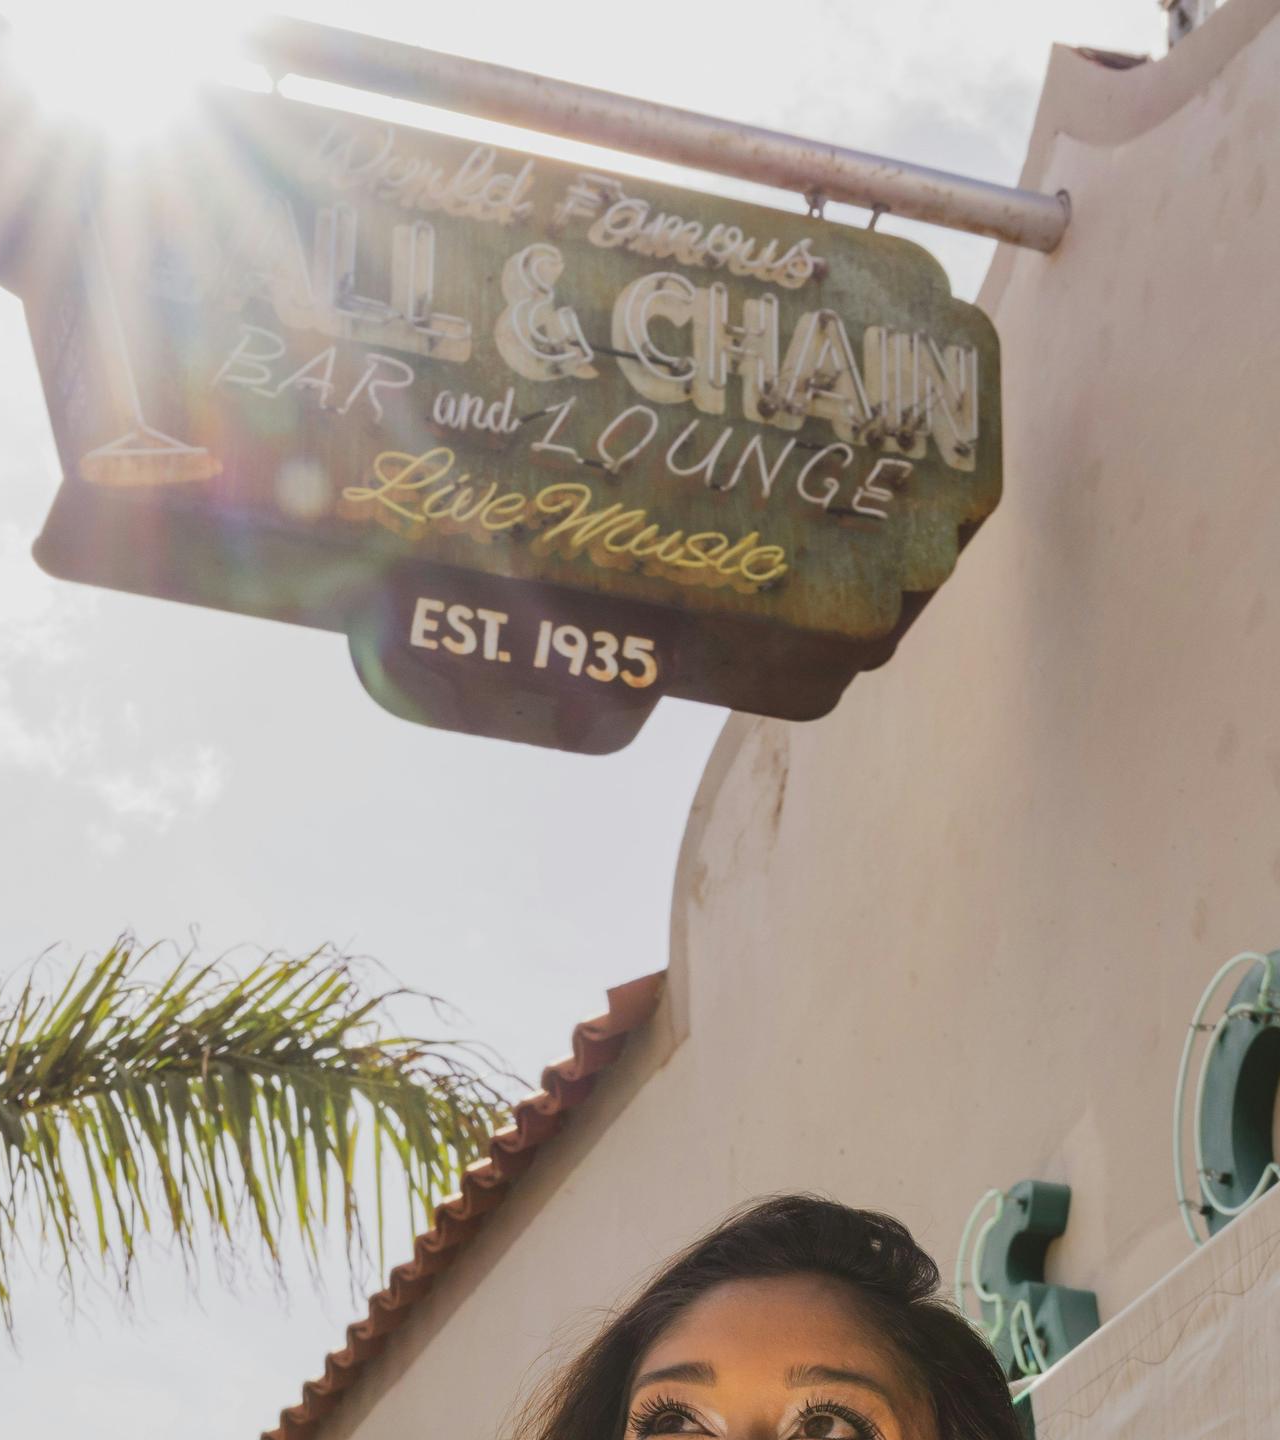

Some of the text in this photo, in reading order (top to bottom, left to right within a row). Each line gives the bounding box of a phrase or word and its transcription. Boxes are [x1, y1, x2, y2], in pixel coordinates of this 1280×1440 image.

[318, 122, 825, 287] World Famous
[215, 323, 913, 519] BAR and LOUNGE
[495, 241, 600, 382] &
[611, 271, 980, 473] CHAIN
[342, 446, 790, 590] Live Music
[409, 597, 658, 688] EST. 1935
